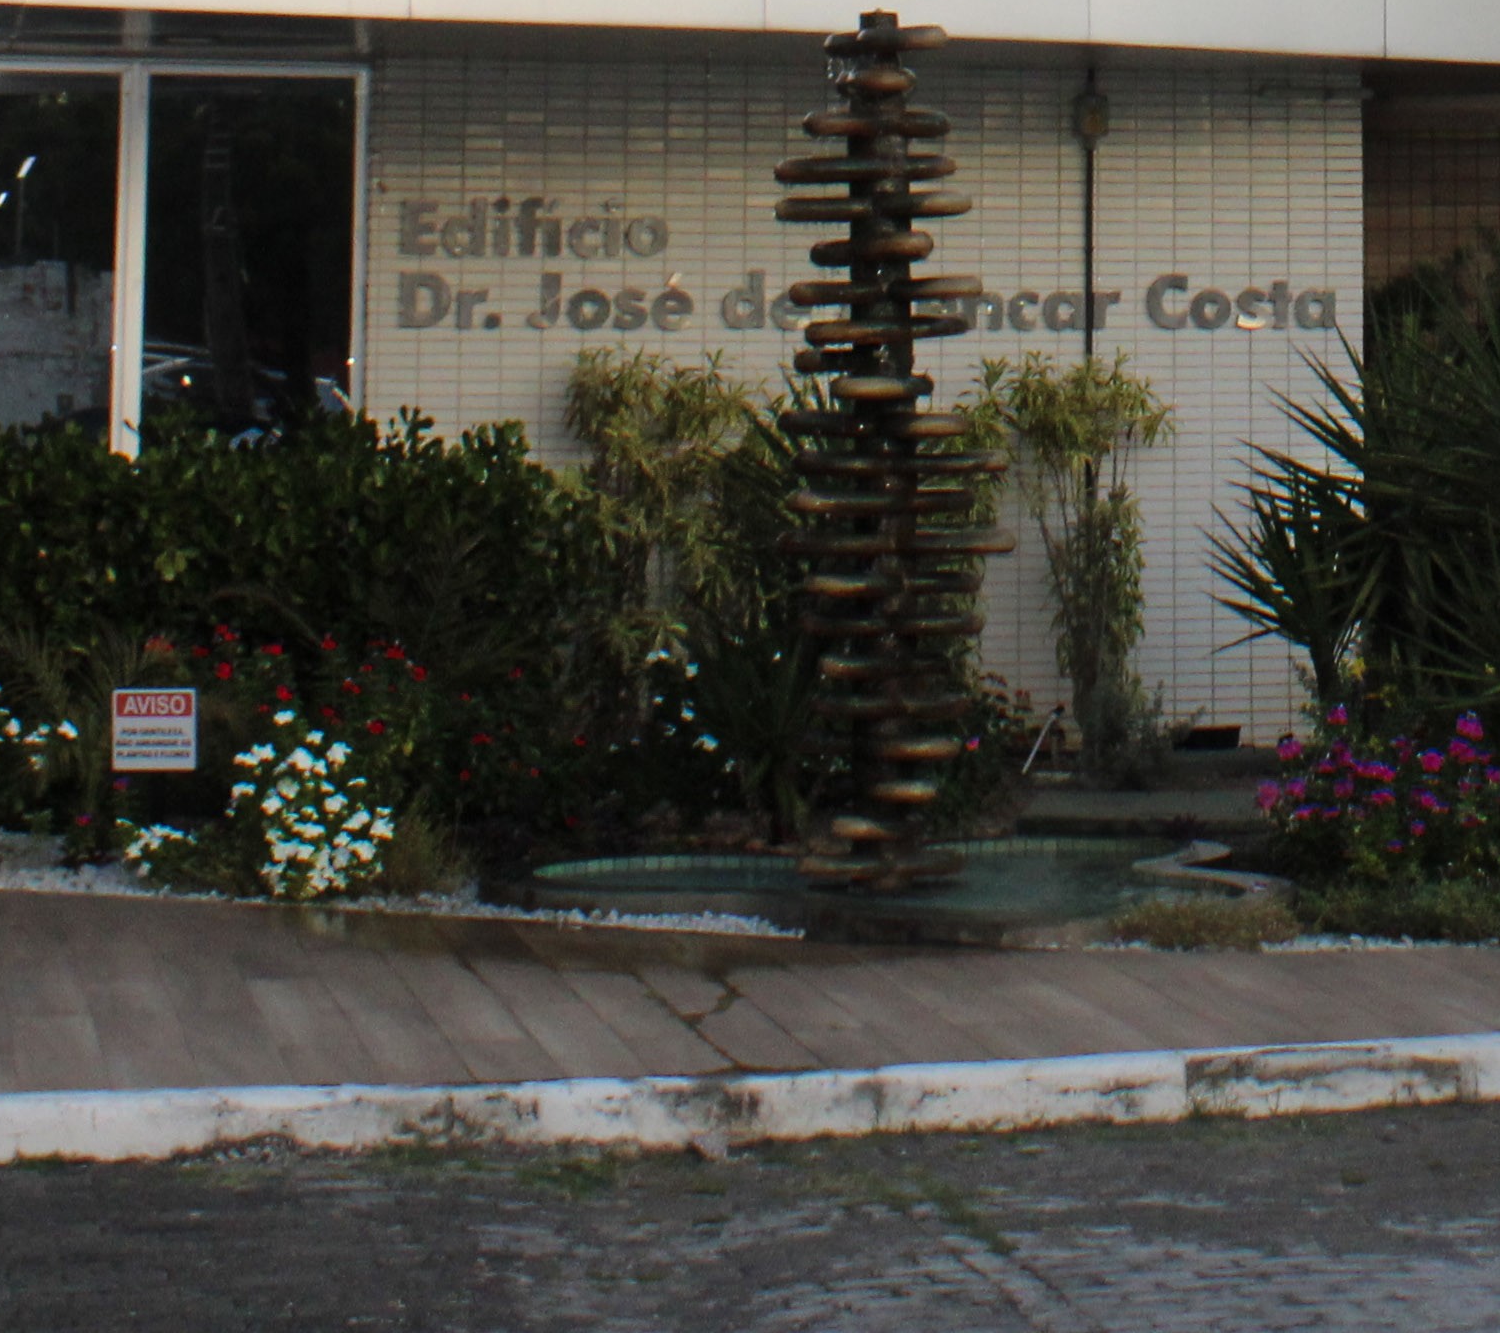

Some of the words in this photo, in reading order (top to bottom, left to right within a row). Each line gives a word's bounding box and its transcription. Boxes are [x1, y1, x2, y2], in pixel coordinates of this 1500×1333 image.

[399, 196, 669, 258] Edifício
[399, 271, 502, 330] Dr.
[526, 271, 695, 331] José
[721, 268, 817, 331] de
[842, 278, 1121, 331] ncar
[1146, 272, 1336, 330] Costa
[123, 694, 186, 715] AVISO
